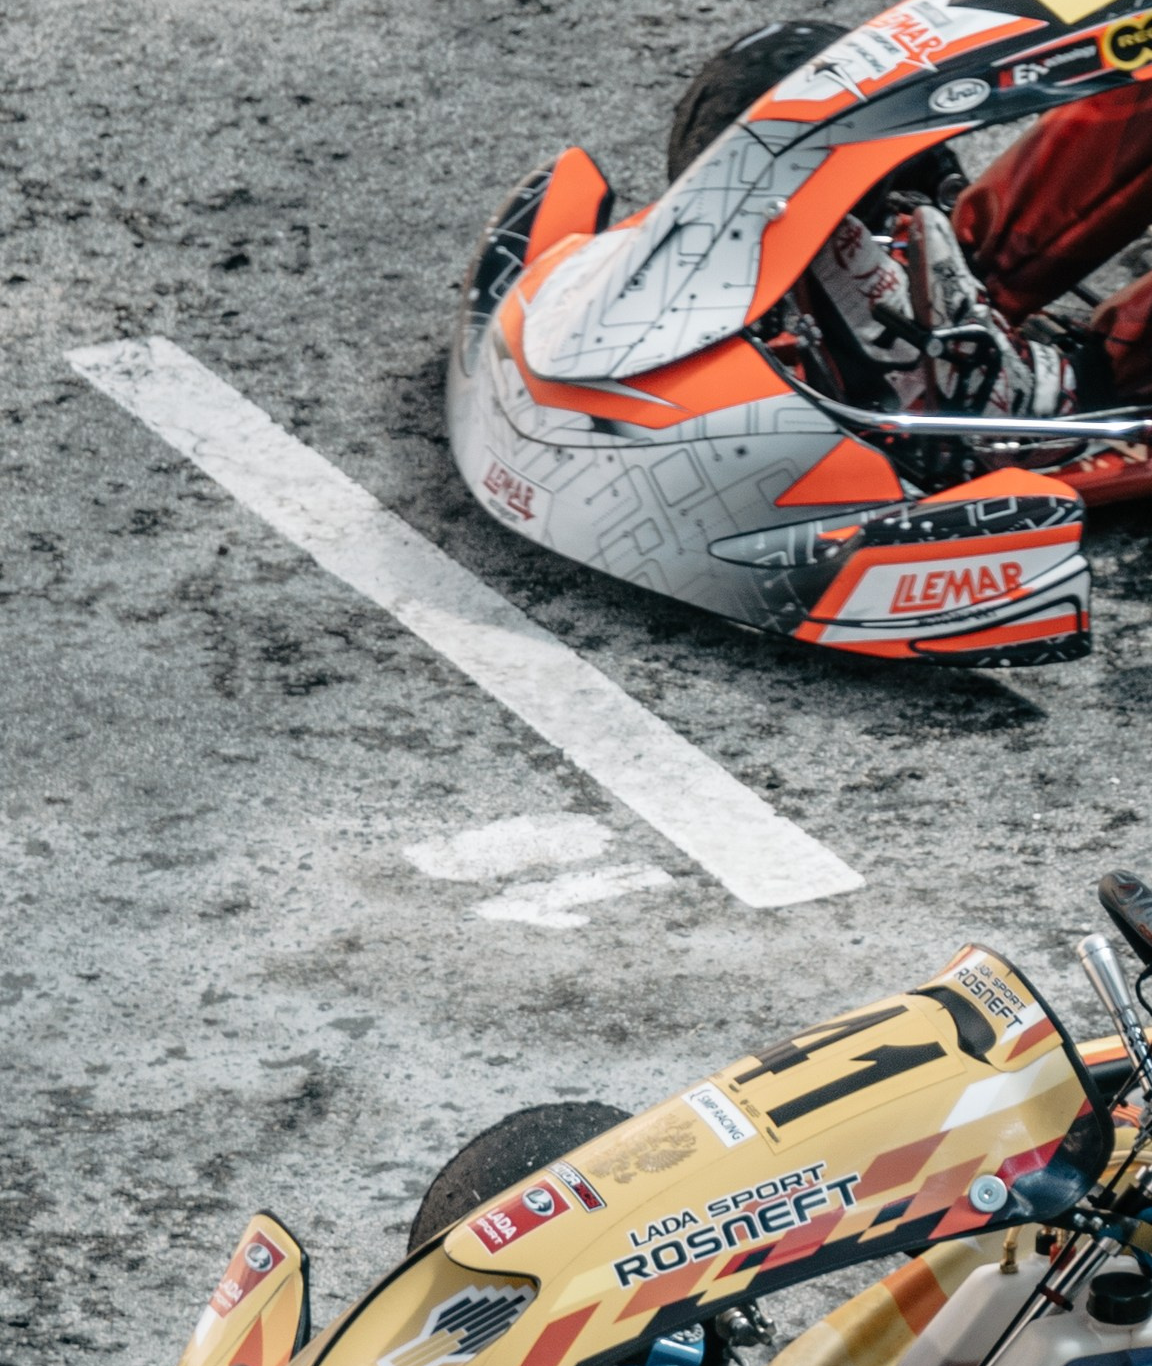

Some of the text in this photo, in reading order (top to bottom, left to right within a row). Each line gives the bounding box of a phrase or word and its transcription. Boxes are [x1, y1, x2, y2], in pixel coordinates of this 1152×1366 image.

[953, 967, 1024, 1029] ROSNEFT
[991, 977, 1027, 1012] SPORT
[733, 1003, 949, 1129] 41
[711, 1105, 745, 1141] RACING
[486, 1207, 518, 1241] LADA
[629, 1162, 826, 1249] LADA SPORT
[475, 1217, 504, 1246] SPORT
[612, 1173, 861, 1288] ROSNEFT
